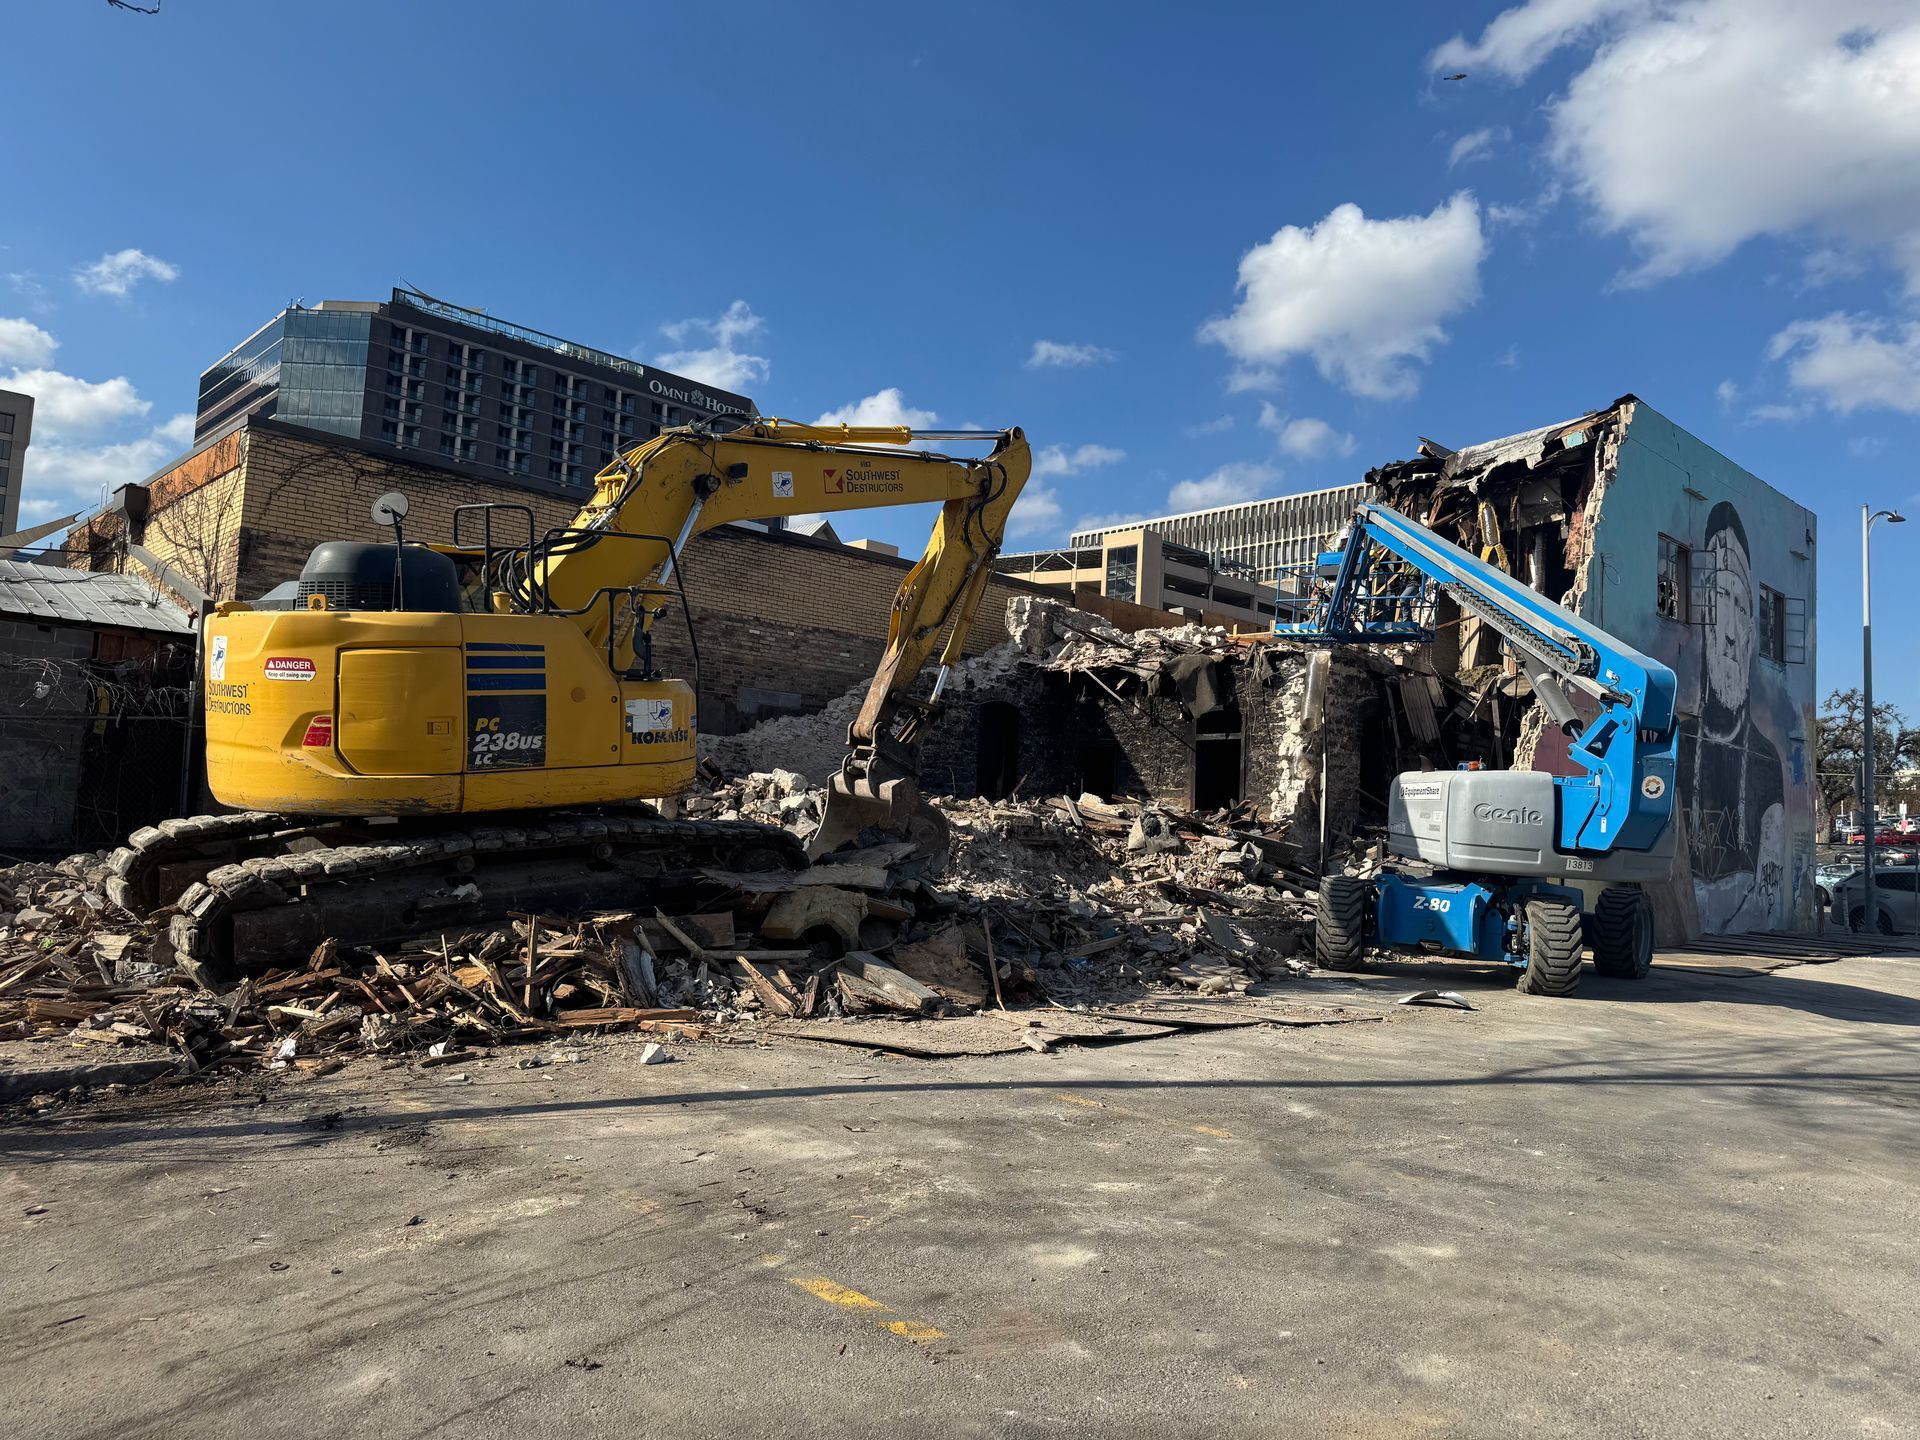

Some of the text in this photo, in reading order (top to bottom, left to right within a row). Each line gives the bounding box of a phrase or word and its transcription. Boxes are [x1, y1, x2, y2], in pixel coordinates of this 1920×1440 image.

[648, 379, 690, 404] OMNI
[846, 469, 901, 481] SOUTHWEST
[847, 481, 904, 493] DESTRUCTORS
[275, 660, 311, 670] DANGER
[208, 680, 249, 699] SOUTHWEST
[475, 717, 500, 732] PC
[632, 729, 689, 745] KOMATSU
[474, 753, 493, 765] LC
[1473, 802, 1543, 825] Genie
[1568, 859, 1593, 870] 13813
[1413, 895, 1451, 913] Z-80
